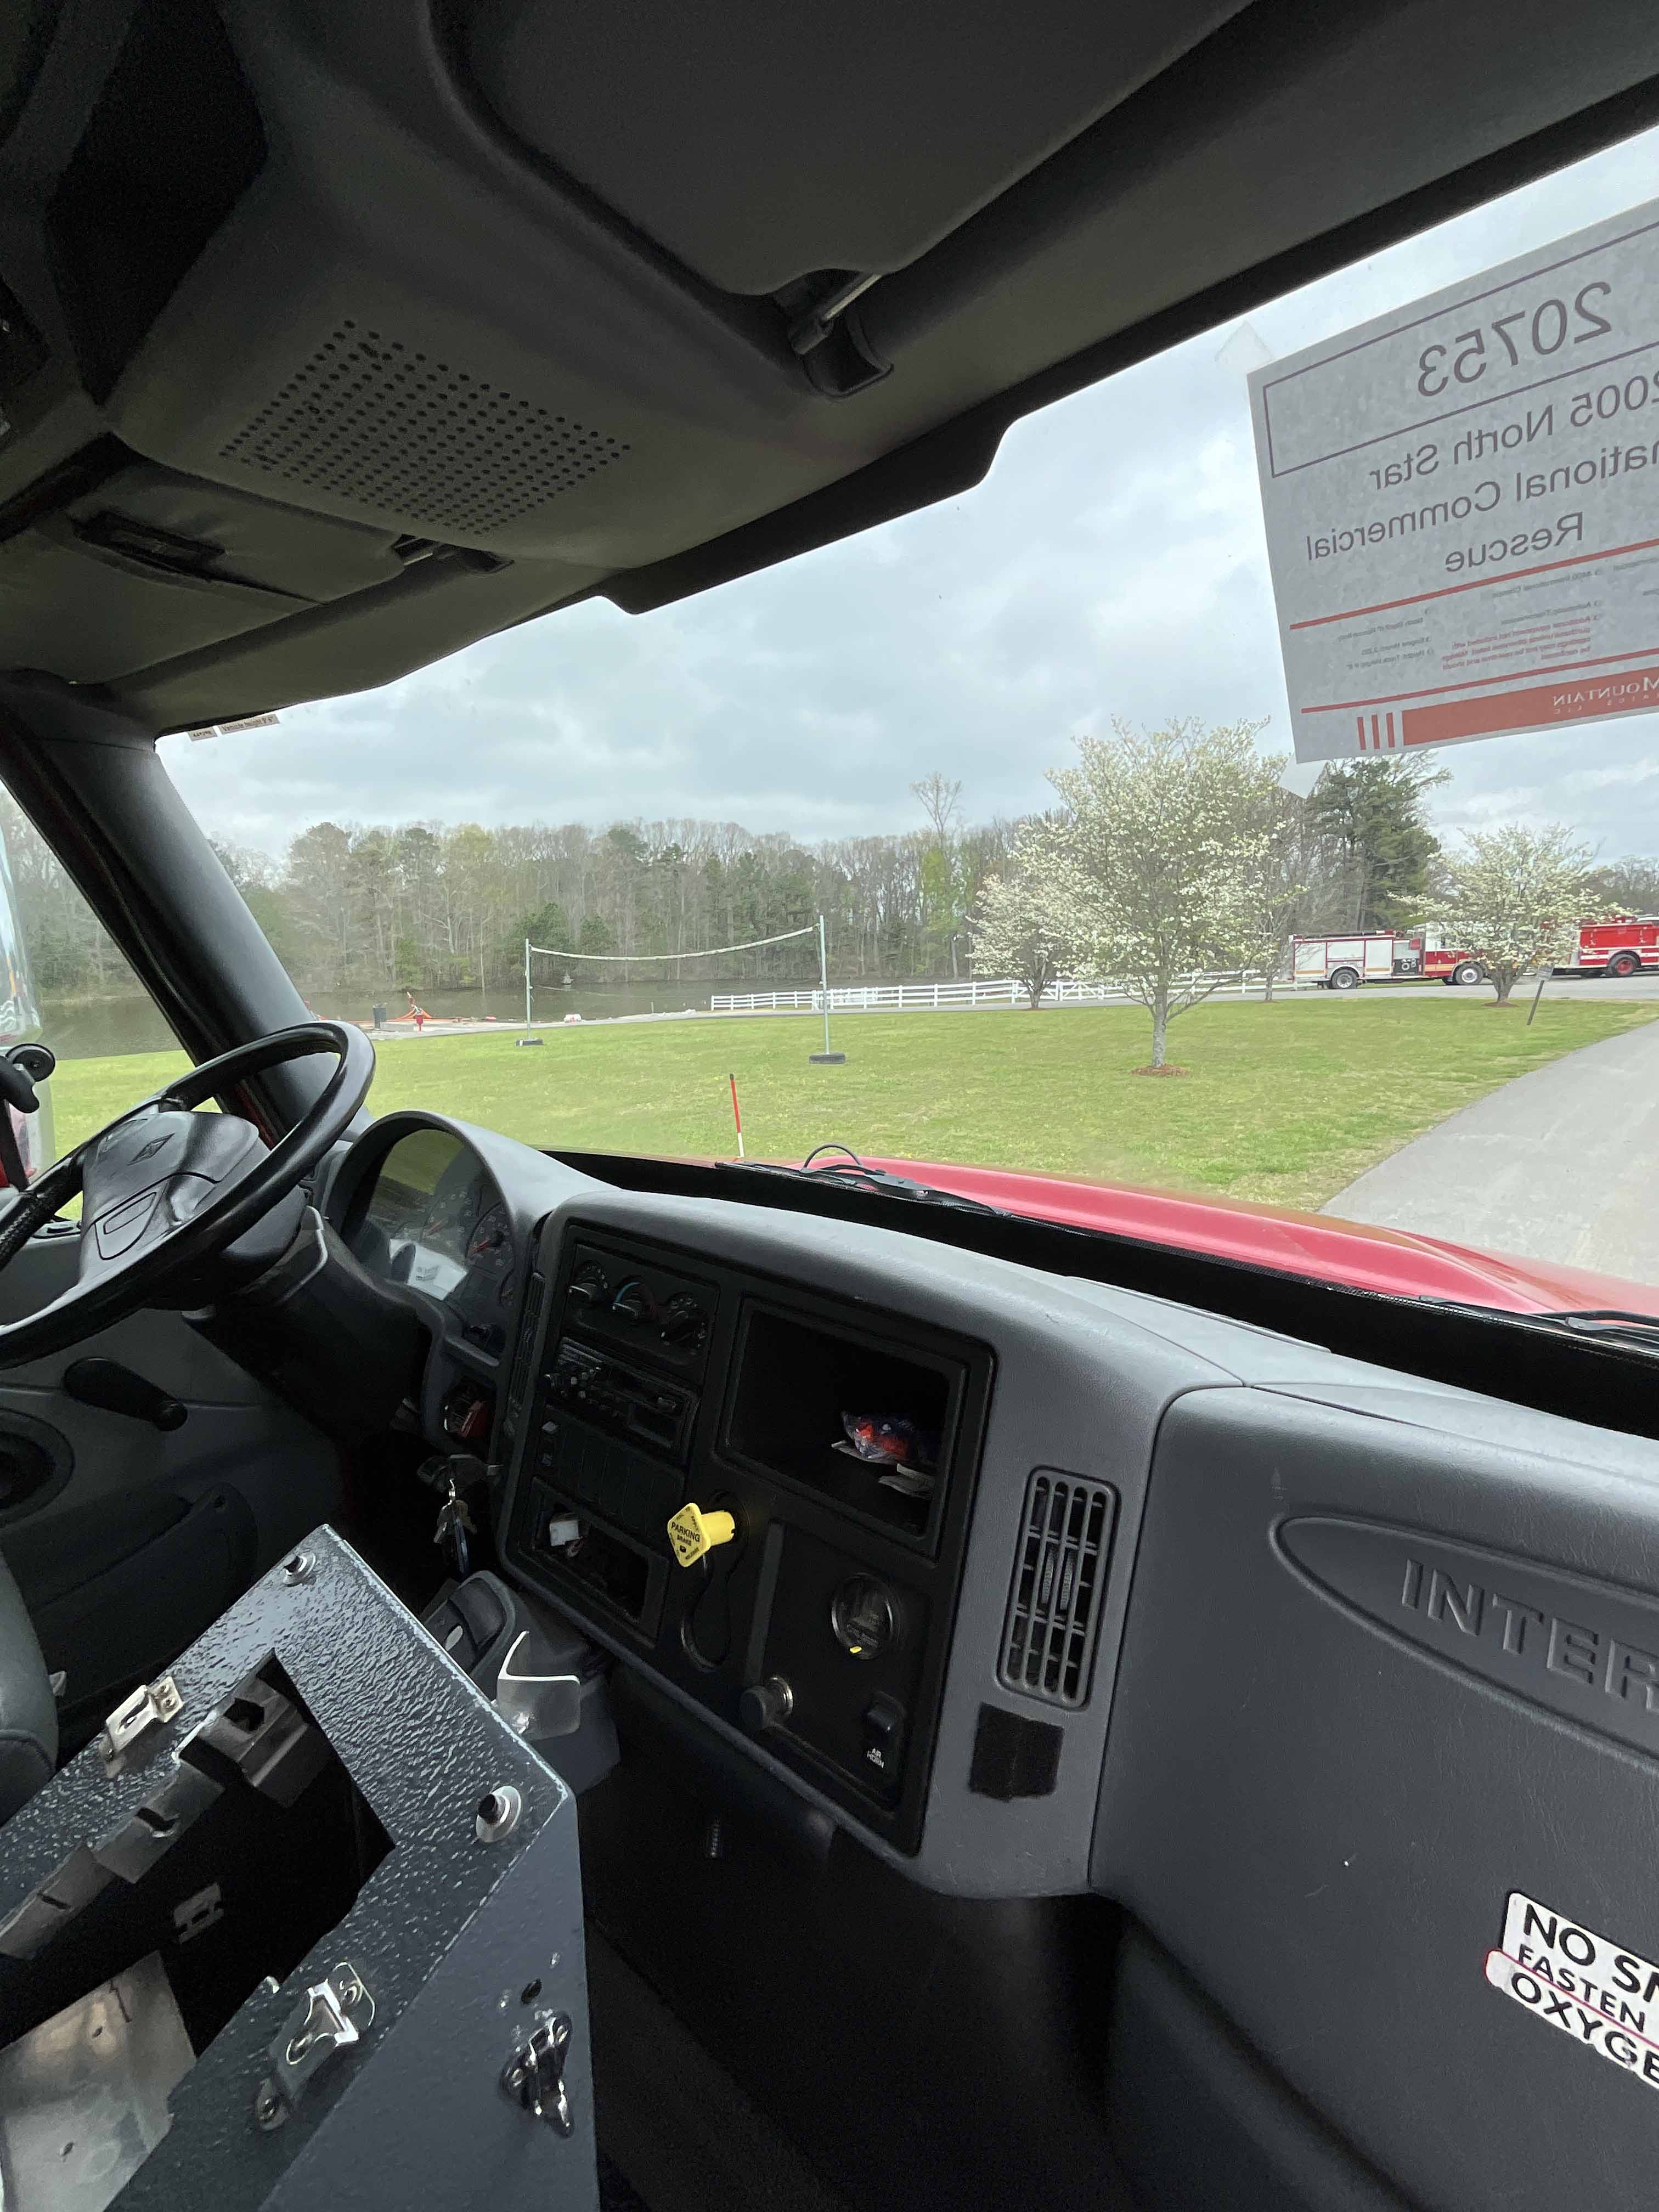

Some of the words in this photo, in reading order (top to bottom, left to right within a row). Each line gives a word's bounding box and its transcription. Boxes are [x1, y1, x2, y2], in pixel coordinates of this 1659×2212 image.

[671, 1521, 700, 1542] PARKING
[1401, 1558, 1659, 1714] INTER
[867, 1751, 884, 1769] HORN
[871, 1747, 882, 1758] AIR
[1523, 1903, 1596, 1966] NO
[1518, 1944, 1645, 2033] FASTEN
